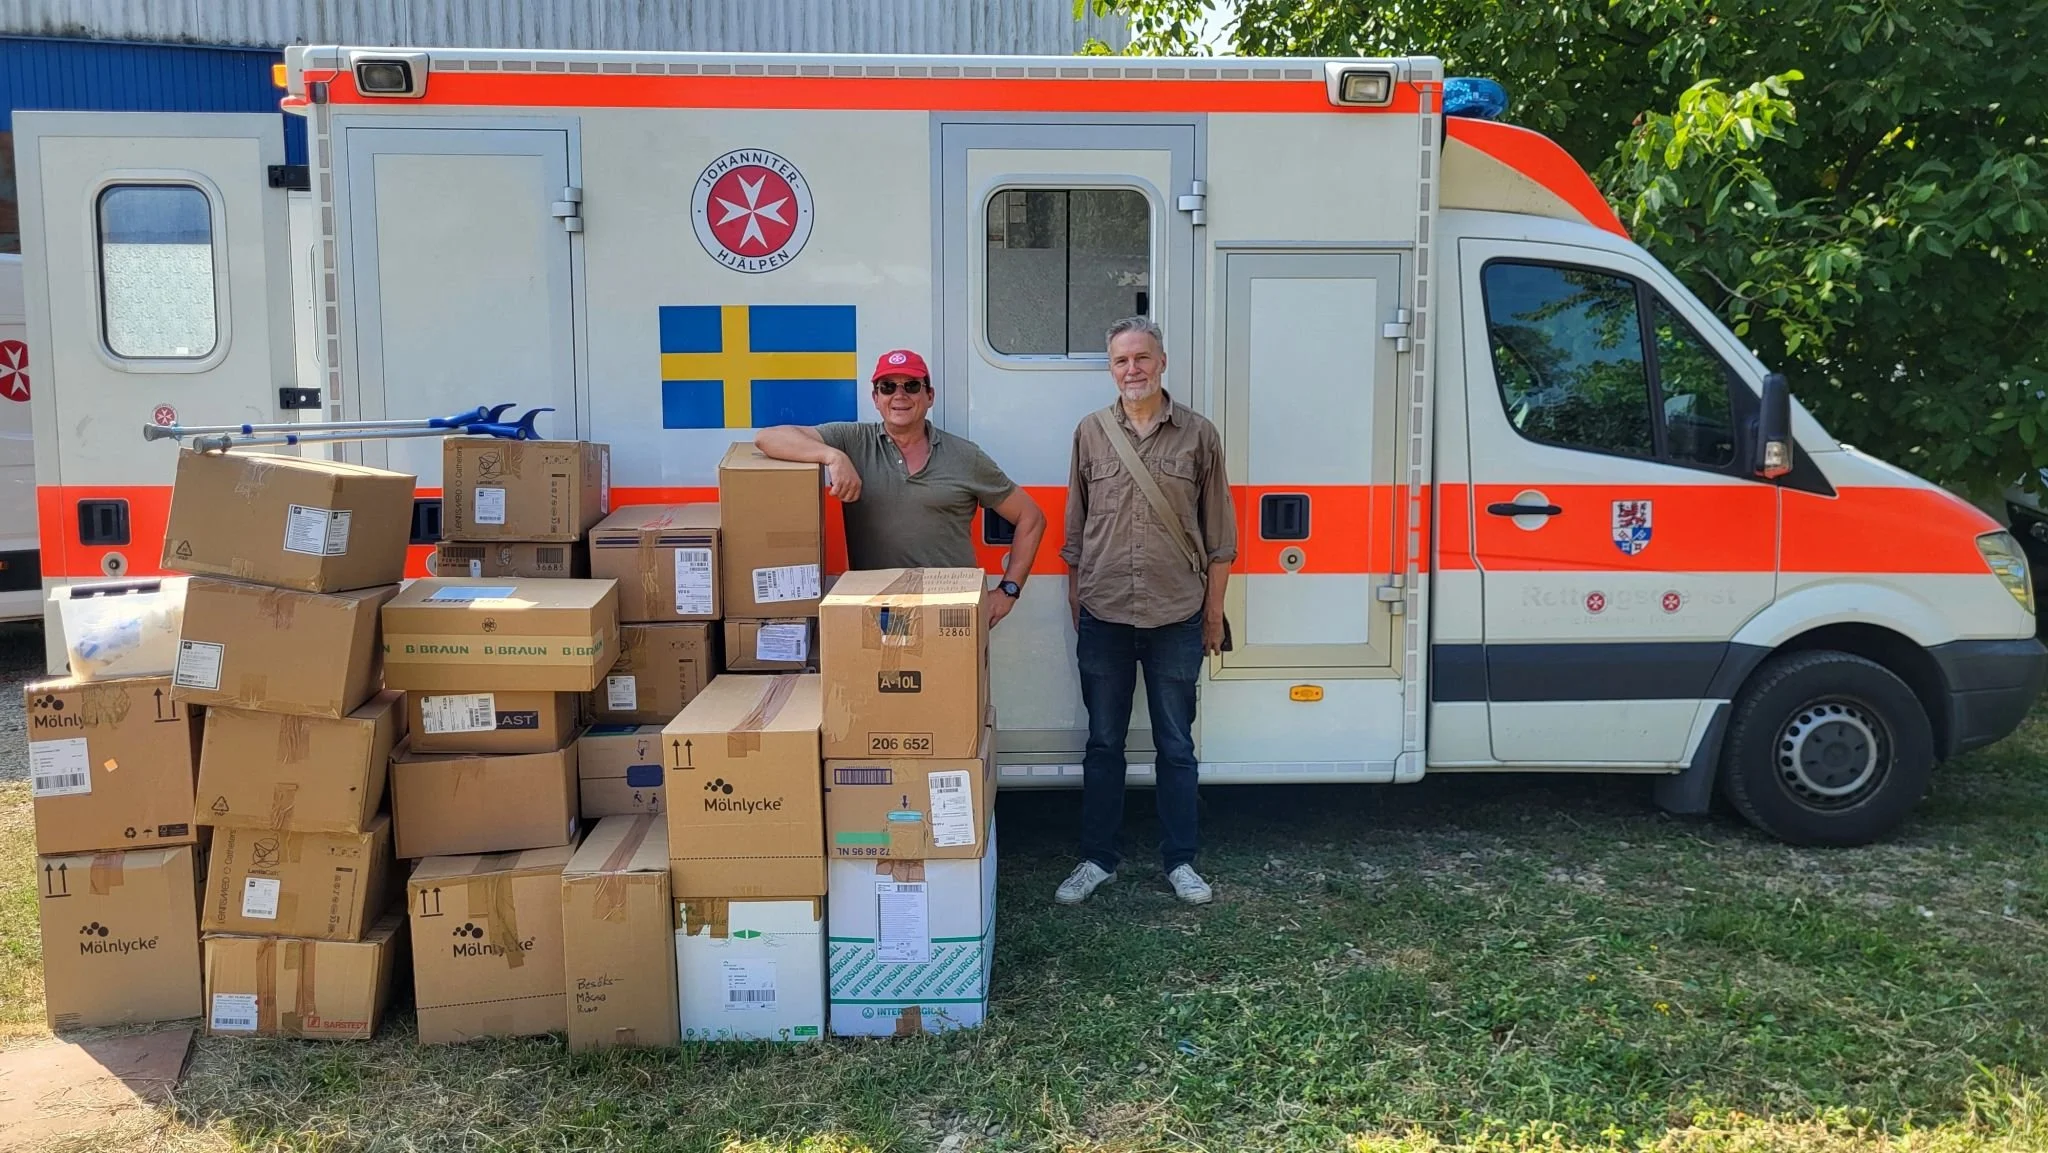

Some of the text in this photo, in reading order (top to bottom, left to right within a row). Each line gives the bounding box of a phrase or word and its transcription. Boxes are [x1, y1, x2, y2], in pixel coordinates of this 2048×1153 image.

[702, 152, 800, 189] JOHANNITER-
[717, 249, 790, 270] HJÄLPEN
[938, 628, 971, 637] 32860
[34, 715, 84, 730] Mölnly
[872, 738, 929, 750] 206 652
[704, 798, 782, 814] Mölnlycke
[836, 847, 891, 856] 72 86 95 NL
[80, 937, 157, 956] Mölnlycke
[453, 940, 534, 958] Mölnlyke
[912, 944, 967, 997] INTERSURGICAL
[877, 1007, 948, 1016] INTERSUGICAL
[323, 1021, 369, 1030] SARSTEDT
